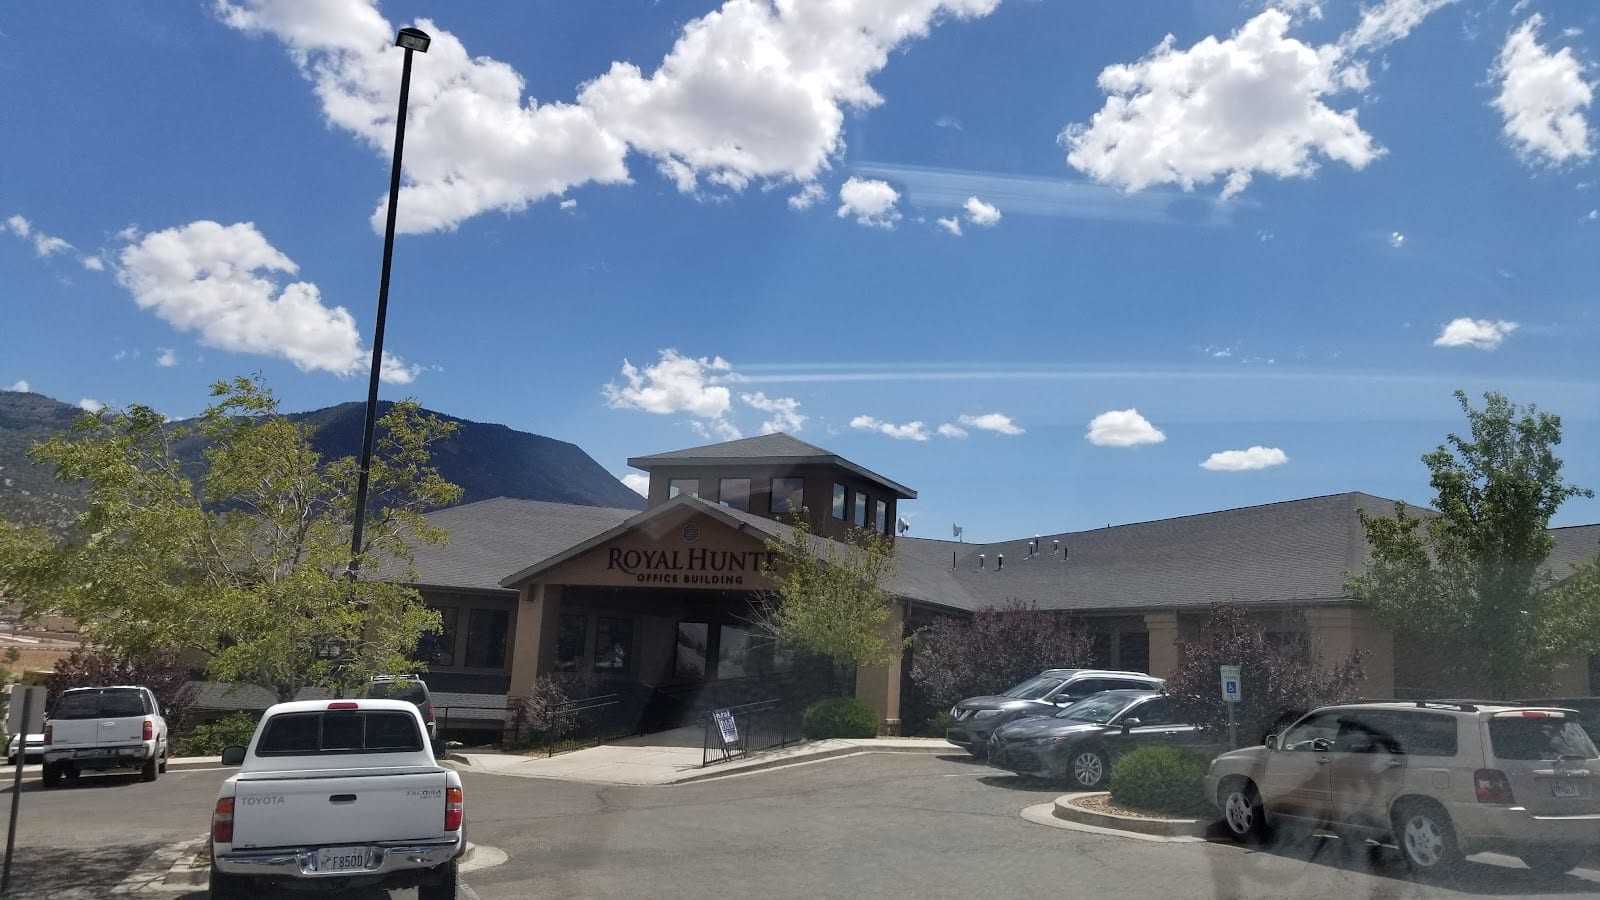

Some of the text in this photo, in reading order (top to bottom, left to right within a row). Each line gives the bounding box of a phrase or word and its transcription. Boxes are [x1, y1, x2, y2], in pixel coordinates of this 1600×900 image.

[607, 547, 683, 575] ROYAL
[636, 572, 744, 585] OFFICE BUILDING
[241, 796, 285, 806] TOYOTA
